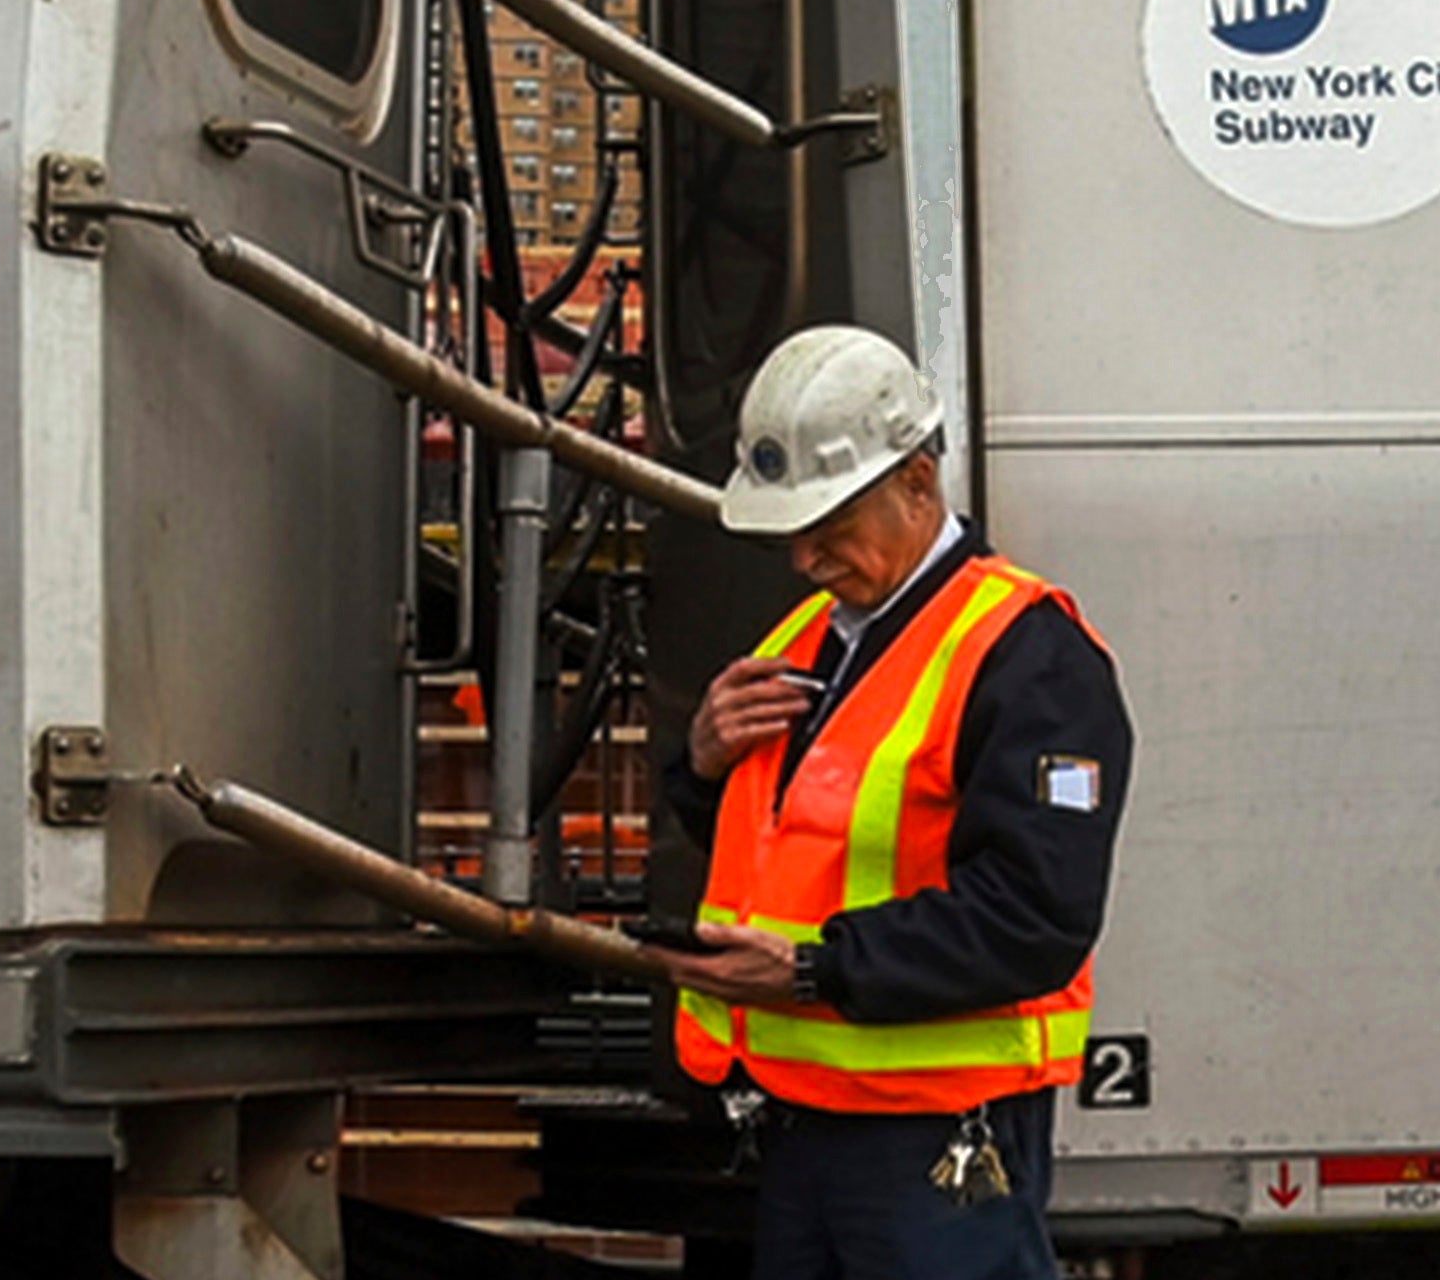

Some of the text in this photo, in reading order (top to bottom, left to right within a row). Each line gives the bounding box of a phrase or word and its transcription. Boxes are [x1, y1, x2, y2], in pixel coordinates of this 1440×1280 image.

[1210, 68, 1296, 104] New
[1306, 65, 1395, 99] York
[1215, 110, 1376, 147] Subway
[1092, 1043, 1134, 1103] 2
